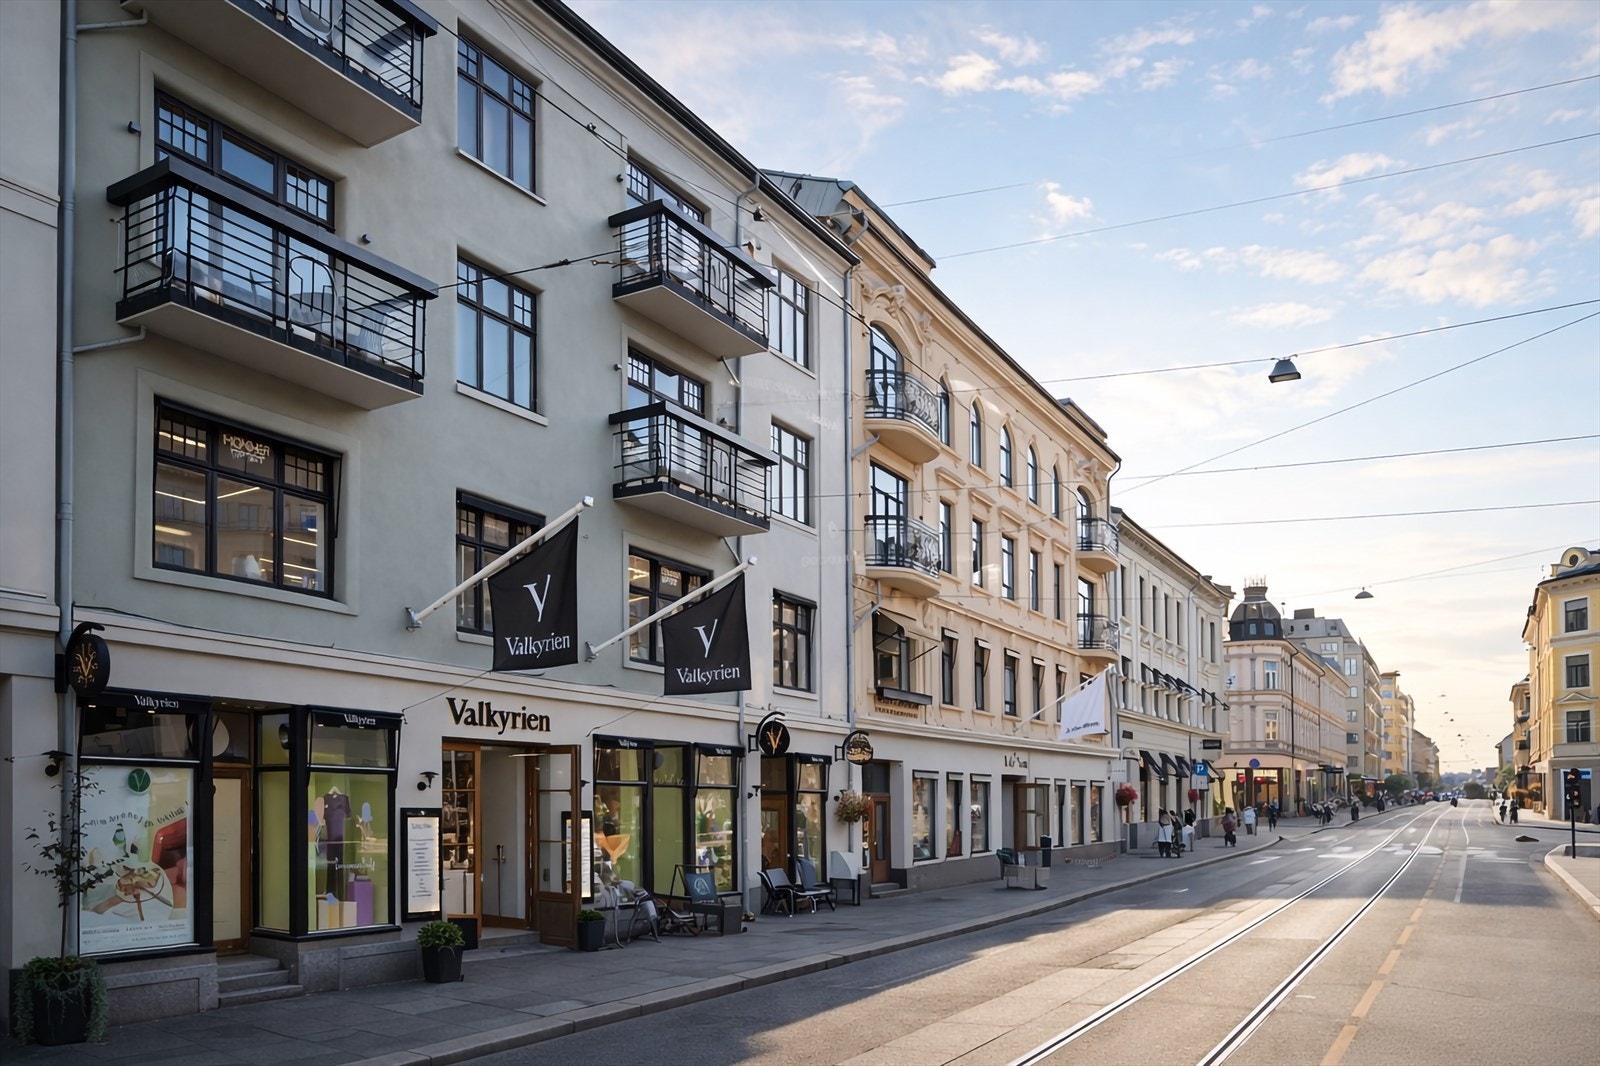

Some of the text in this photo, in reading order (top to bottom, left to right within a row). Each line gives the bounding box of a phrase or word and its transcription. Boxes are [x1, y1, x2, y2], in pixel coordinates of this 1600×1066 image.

[504, 632, 571, 659] Valkyrien
[675, 664, 741, 686] Valkyrien
[445, 696, 552, 735] Valkyrien
[1196, 764, 1205, 774] P
